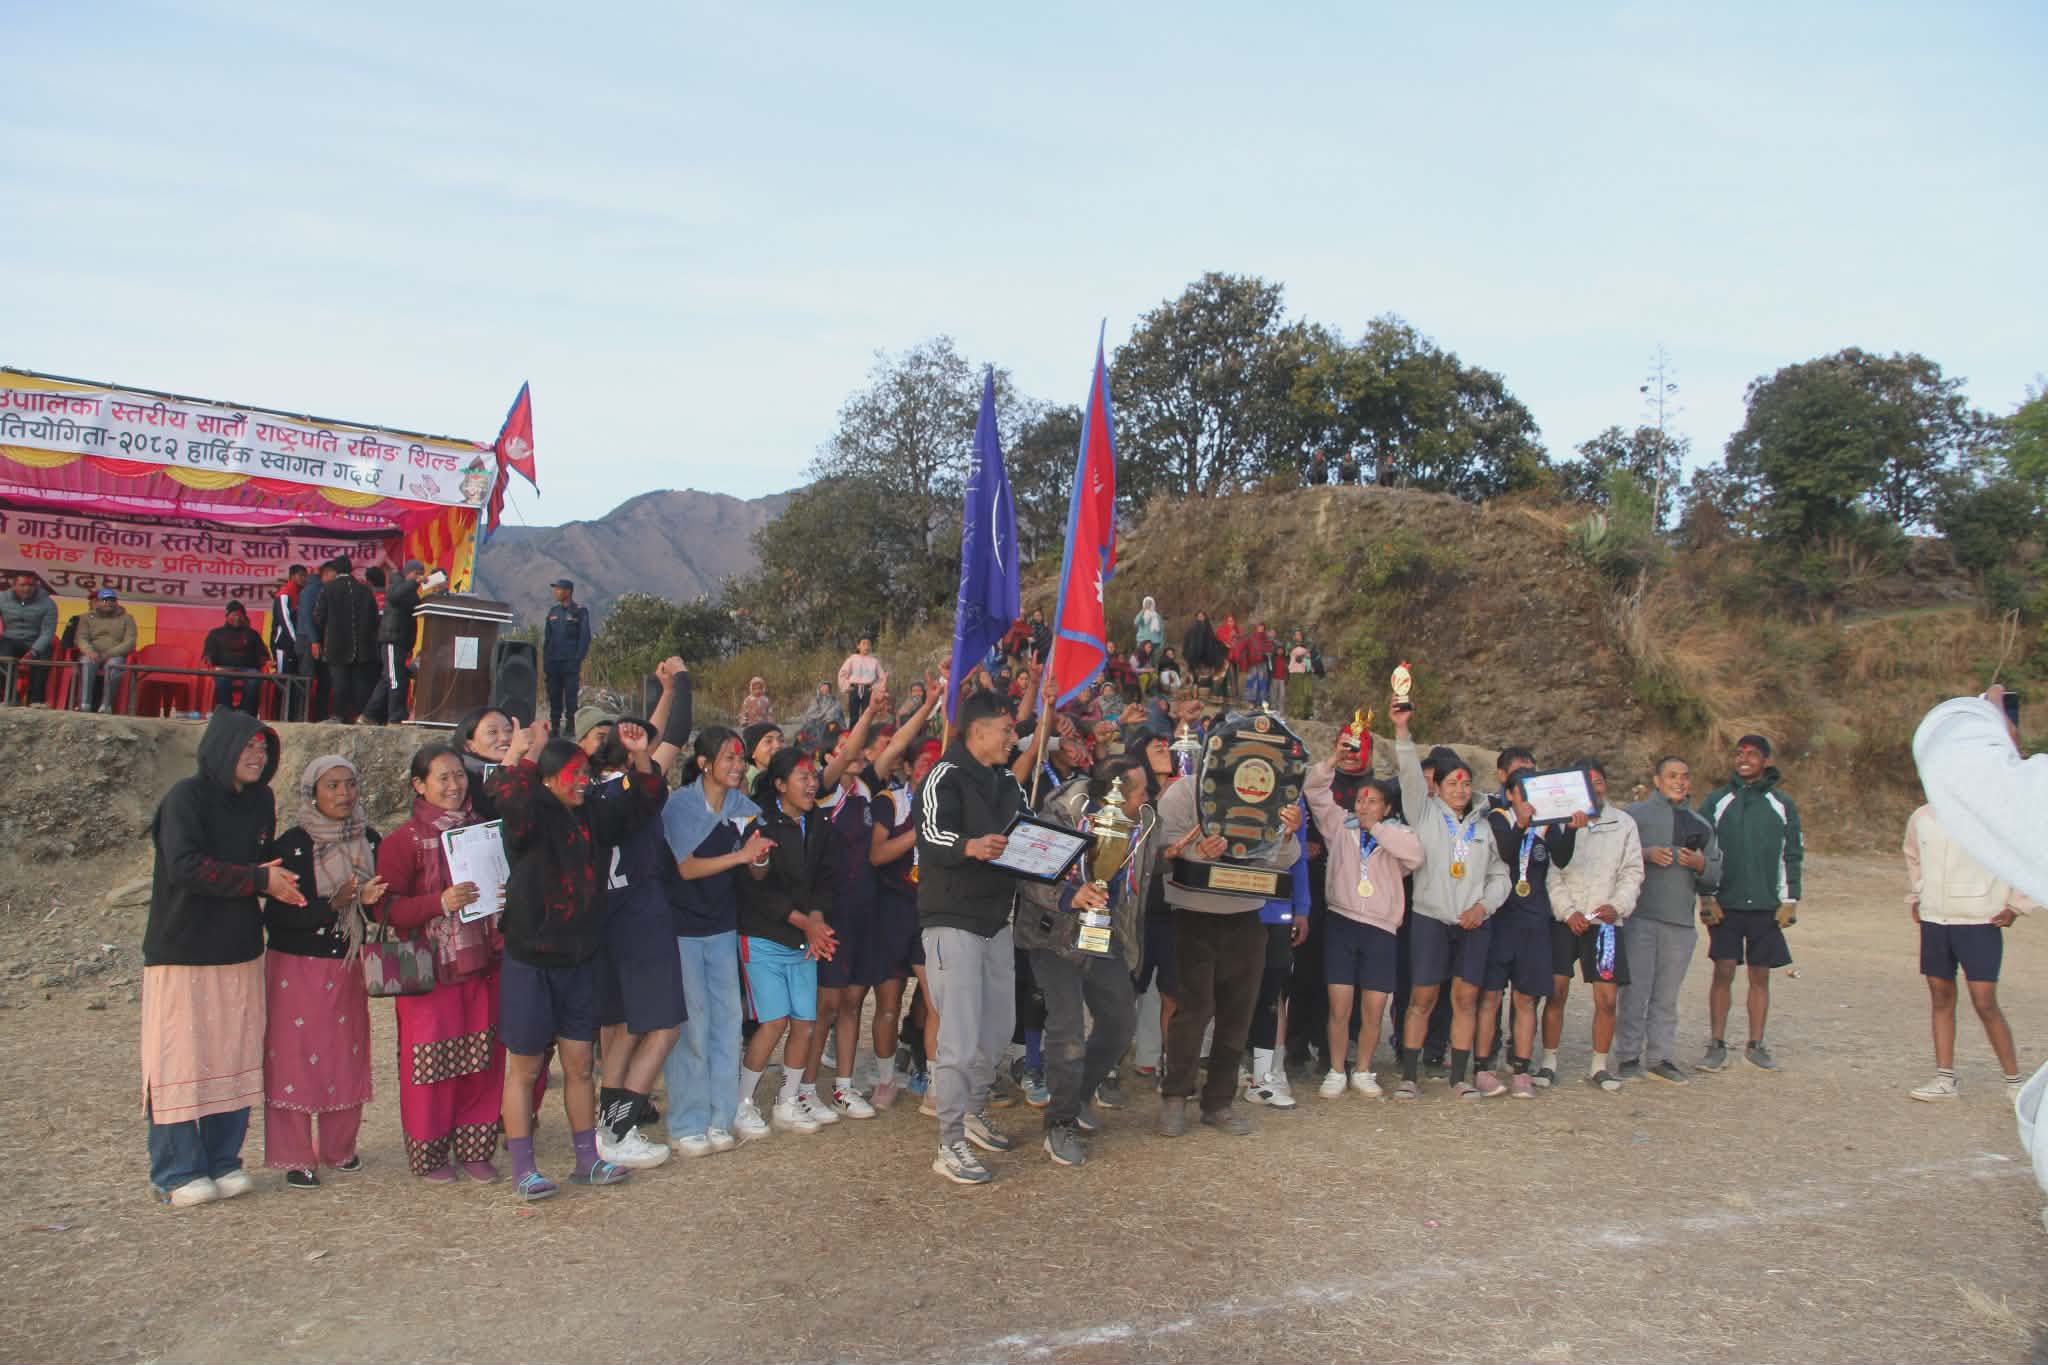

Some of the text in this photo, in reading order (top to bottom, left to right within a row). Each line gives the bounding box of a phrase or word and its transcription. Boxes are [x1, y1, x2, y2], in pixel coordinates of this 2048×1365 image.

[0, 413, 179, 460] तियोगिता-२०८२
[187, 438, 254, 466] हार्दिक
[260, 451, 327, 477] स्वागत
[111, 402, 189, 429] स्तरीय
[256, 423, 341, 452] राष्ट्रपति
[347, 436, 402, 462] रनिङ
[408, 444, 460, 472] शिल्ड
[19, 541, 88, 562] रनिङ
[93, 547, 156, 569] शिल्ड
[161, 531, 235, 555] स्तरीय
[200, 578, 288, 601] समार
